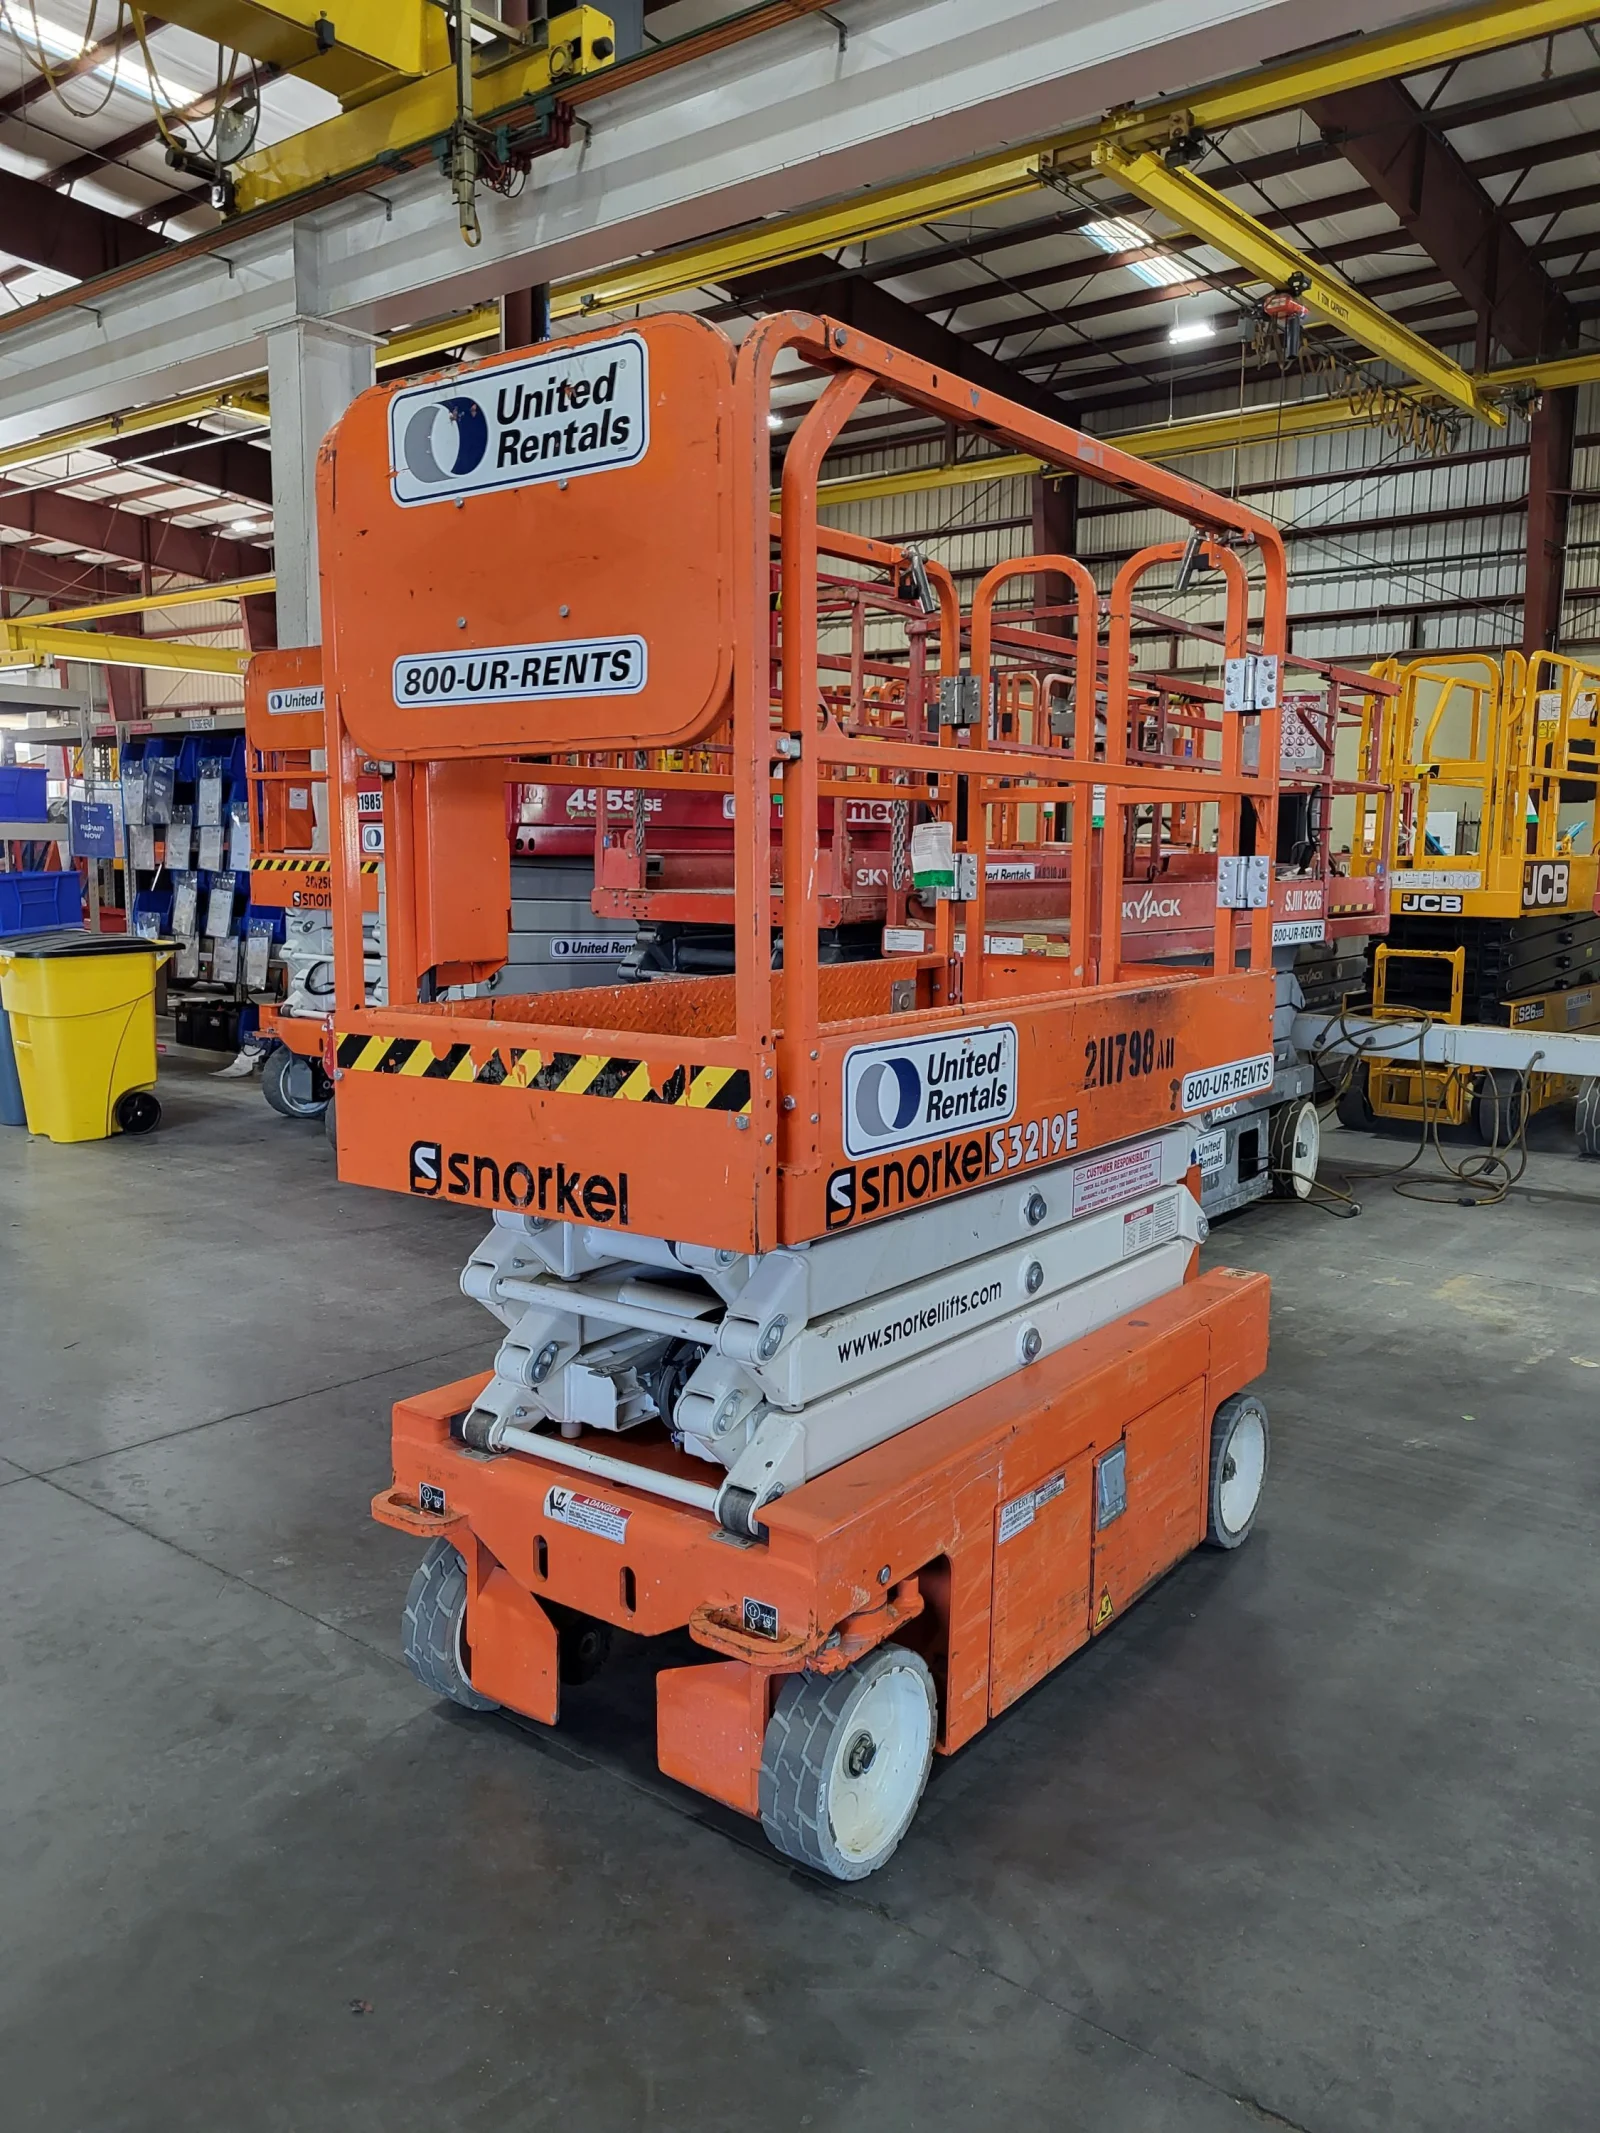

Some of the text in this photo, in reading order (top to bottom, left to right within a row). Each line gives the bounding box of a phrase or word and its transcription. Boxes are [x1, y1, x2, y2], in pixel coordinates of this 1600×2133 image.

[497, 361, 618, 426] United
[496, 408, 630, 469] Rentals
[403, 648, 632, 696] 800-UR-RENTS
[284, 692, 318, 708] United
[80, 823, 105, 833] REPAIR
[84, 832, 101, 840] NOW
[1001, 868, 1032, 880] Rentals
[1523, 864, 1568, 906] JCB
[1303, 890, 1323, 911] 3226
[1402, 894, 1462, 912] JCB
[571, 941, 609, 954] United
[1273, 924, 1323, 943] 800-UR-RENTS
[926, 1041, 1003, 1086] United
[1186, 1060, 1270, 1103] 800-UR-RENTS
[926, 1077, 1008, 1123] Rentals
[1198, 1136, 1223, 1157] United
[861, 1108, 1079, 1216] snorkel S3219E
[1086, 1149, 1151, 1179] CUSTOMER RESPONSIBILITY
[448, 1152, 629, 1226] snorkel
[837, 1281, 1002, 1364] www.snorkellifts.com
[589, 1499, 621, 1515] DANGER
